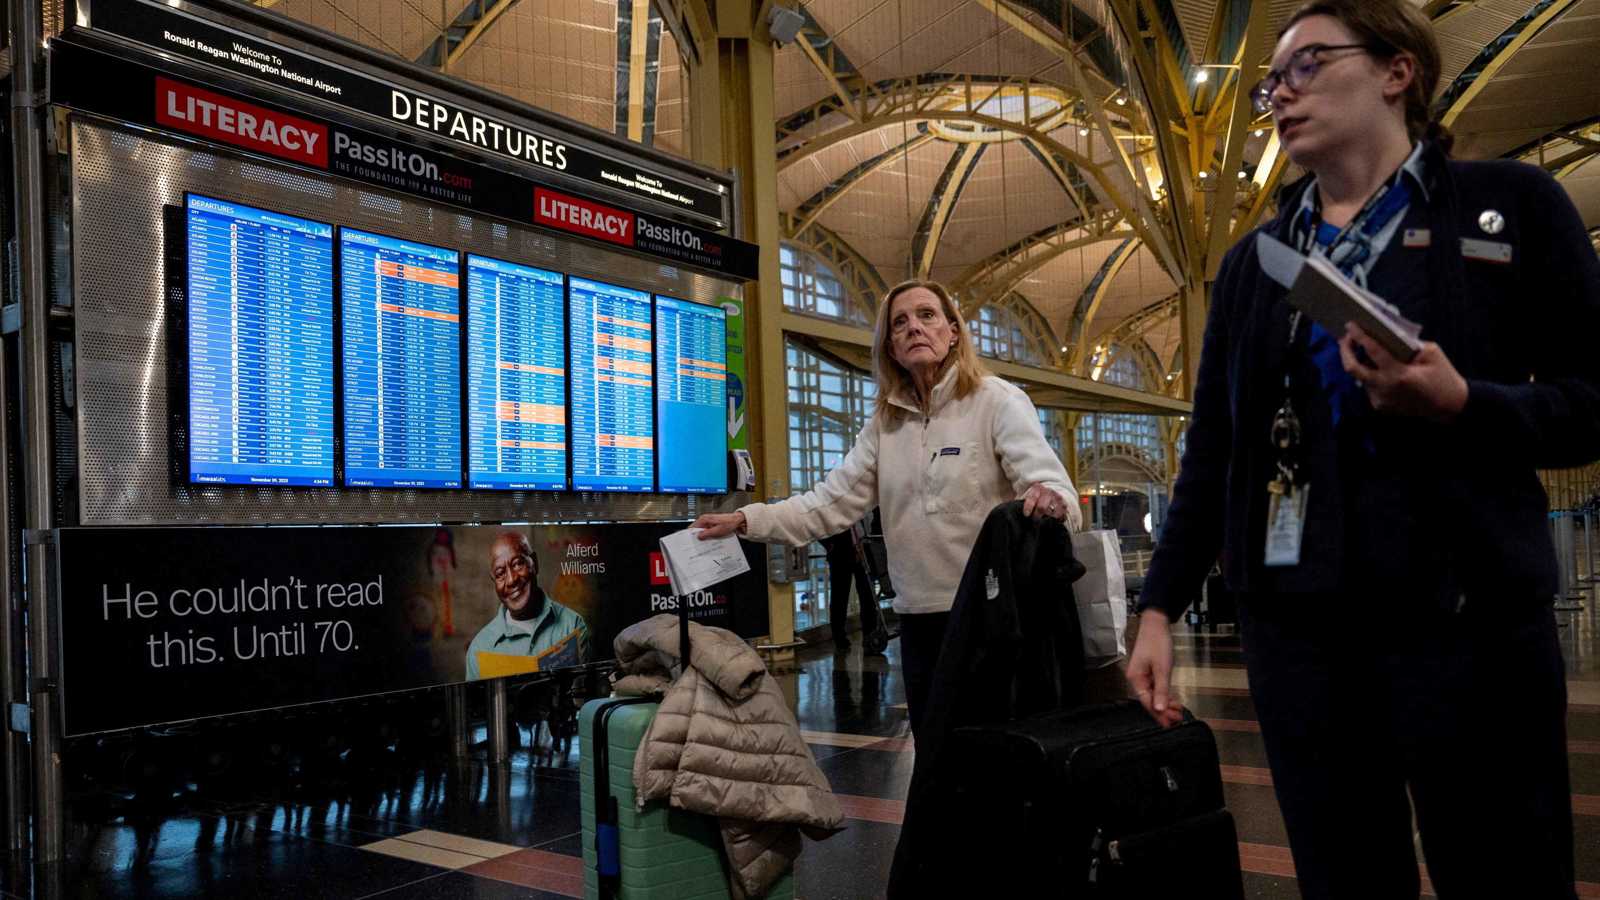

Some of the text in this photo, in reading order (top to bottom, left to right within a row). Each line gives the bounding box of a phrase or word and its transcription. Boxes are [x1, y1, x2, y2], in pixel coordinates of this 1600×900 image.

[164, 30, 342, 96] Ronald Reagan Washington National Airport
[233, 42, 282, 66] Welcome To
[167, 90, 319, 155] LITERACY
[391, 90, 568, 170] DEPARTURES
[334, 131, 473, 190] PassItOn.com
[600, 170, 618, 183] Ronald
[635, 173, 657, 187] Welcome
[540, 196, 629, 238] LITERACY
[560, 561, 606, 575] Williams
[102, 583, 158, 620] He
[316, 574, 384, 608] read
[146, 620, 359, 668] this. Until 70.
